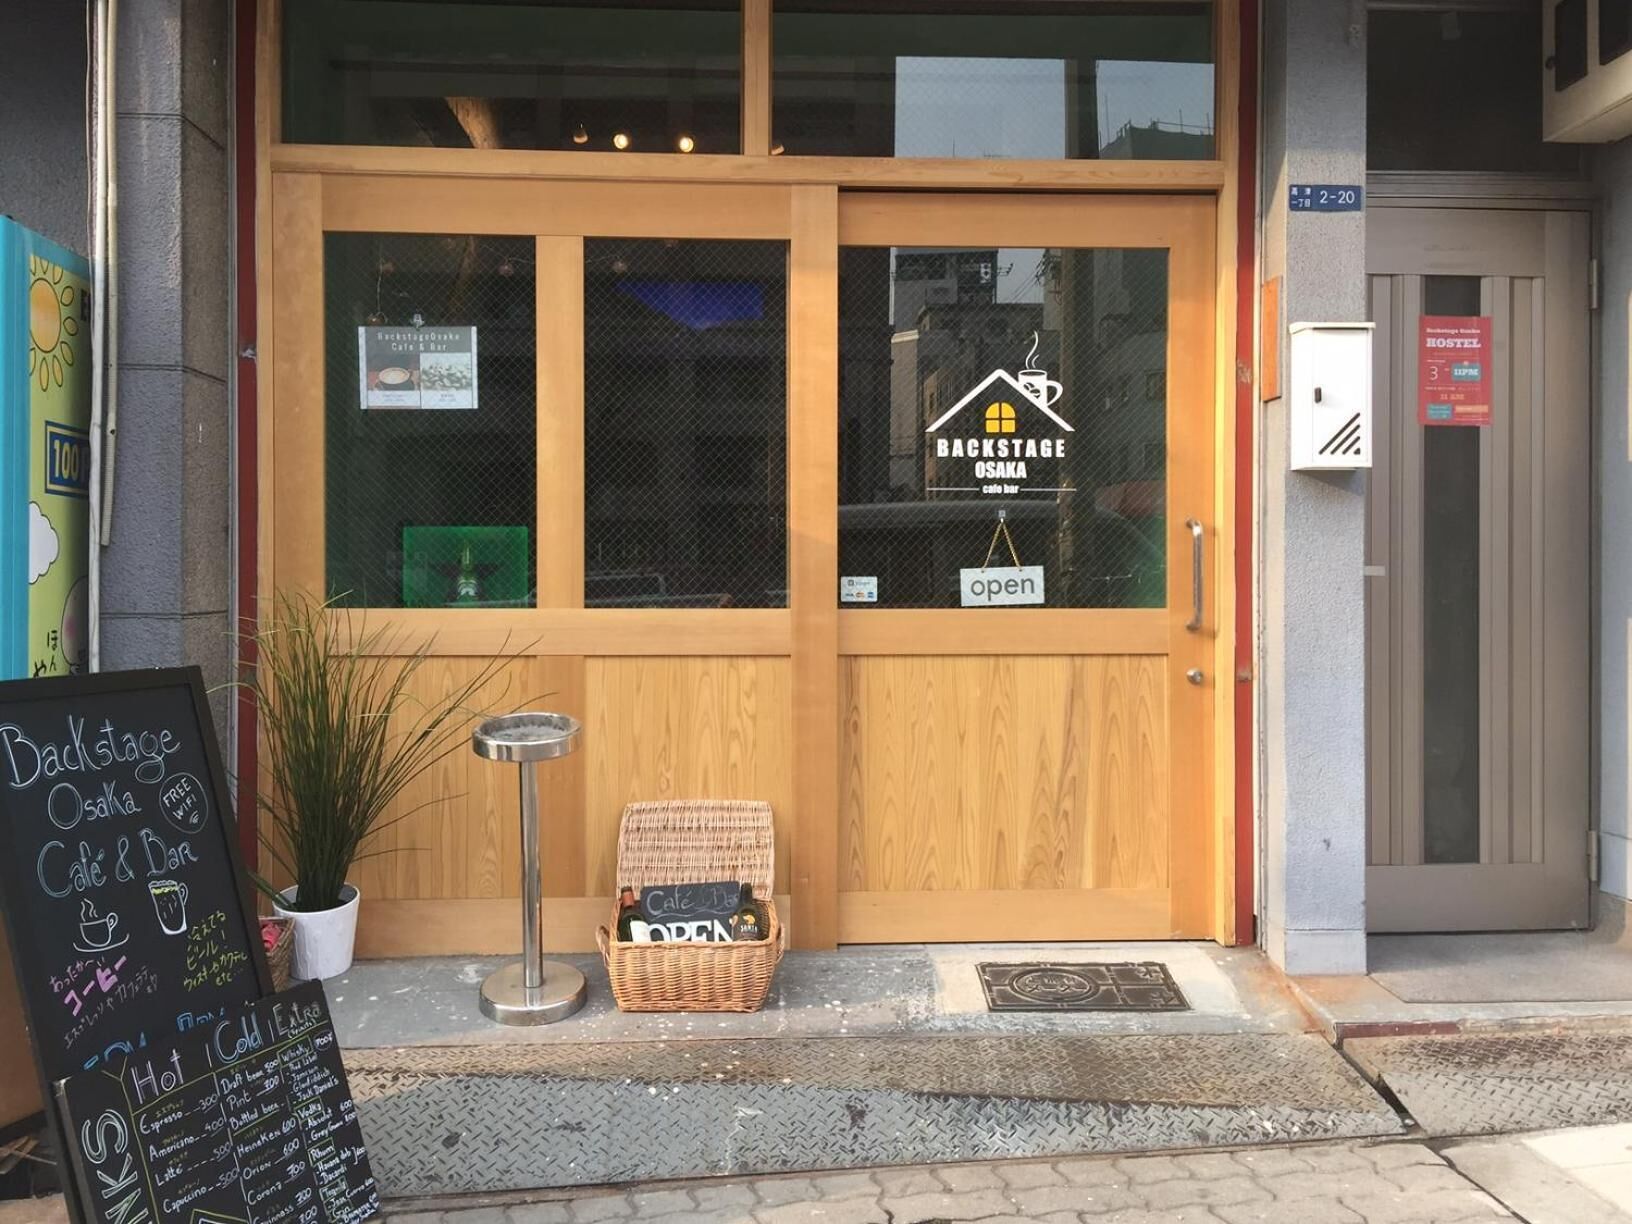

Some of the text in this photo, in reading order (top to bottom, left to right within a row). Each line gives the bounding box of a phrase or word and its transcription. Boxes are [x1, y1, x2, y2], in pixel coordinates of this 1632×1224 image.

[1319, 190, 1355, 204] 2-20
[1426, 337, 1481, 348] HOSTEL
[936, 438, 1066, 458] BACKSTAGE
[974, 461, 1027, 479] OSAKA
[1004, 484, 1020, 494] bar
[970, 577, 1035, 602] open
[0, 714, 181, 788] Backstage
[163, 777, 192, 808] FREE
[48, 780, 142, 830] Osaka
[115, 835, 135, 882] &
[130, 1048, 184, 1104] Hot
[213, 1011, 264, 1064] Cold
[220, 1072, 243, 1095] Draft
[139, 1111, 183, 1134] Espresso
[199, 1093, 219, 1111] 300
[149, 1135, 195, 1162] Americano
[204, 1117, 224, 1132] 400
[243, 1160, 271, 1179] Orion
[247, 1181, 282, 1205] Corona
